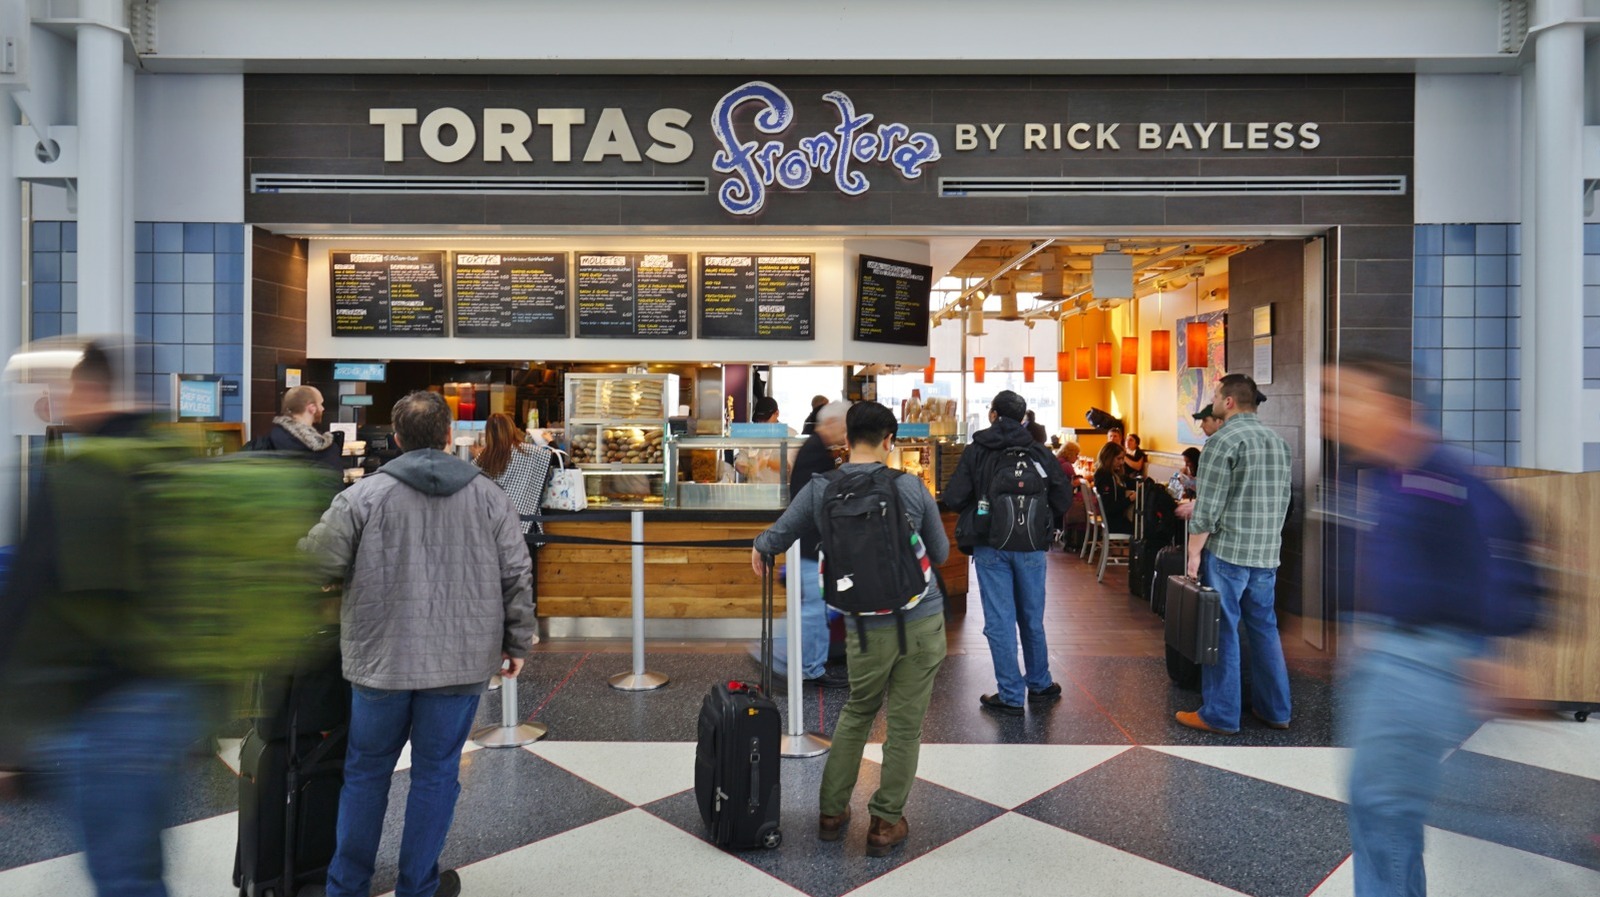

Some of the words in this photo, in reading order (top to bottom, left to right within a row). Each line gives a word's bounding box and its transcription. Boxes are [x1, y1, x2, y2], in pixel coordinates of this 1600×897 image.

[369, 106, 694, 164] TORTAS
[955, 122, 1006, 151] BY
[1024, 122, 1121, 150] RICK
[1138, 121, 1322, 150] BAYLESS
